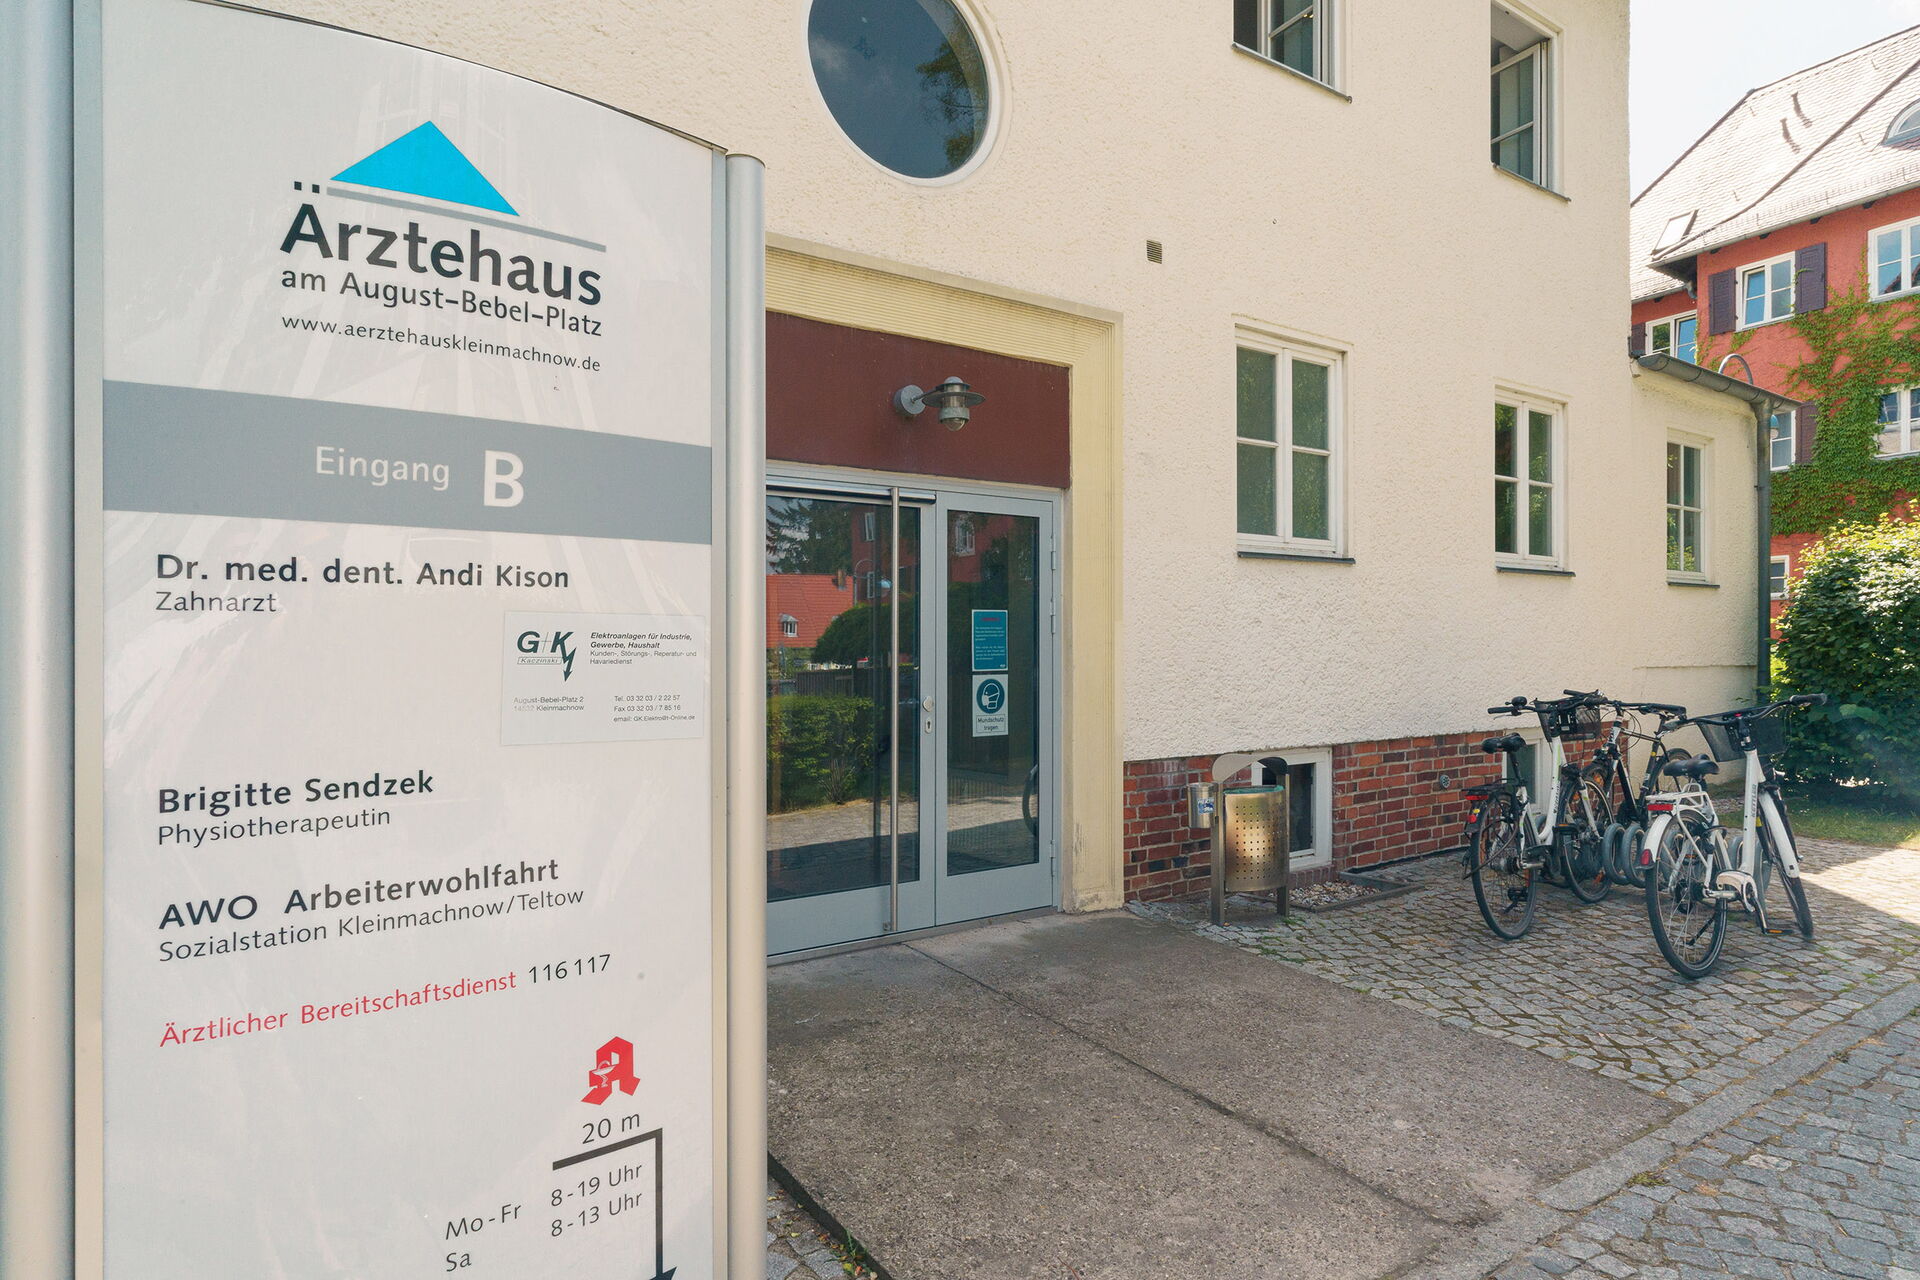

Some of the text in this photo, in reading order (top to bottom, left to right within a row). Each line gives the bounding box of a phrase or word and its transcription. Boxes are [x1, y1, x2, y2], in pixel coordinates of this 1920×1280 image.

[280, 181, 601, 306] Ärztehaus
[281, 270, 602, 337] am August-Bebel-Platz
[282, 315, 601, 372] www.aerztehauskleinmachnow.de
[315, 446, 525, 507] Eingang B
[157, 554, 569, 588] Dr. med. dent. Andi Kison
[156, 591, 277, 612] Zahnarzt
[590, 632, 646, 641] Elektroanlagen
[660, 633, 692, 641] Industrie,
[590, 641, 626, 649] Gewerbe,
[513, 696, 578, 704] August-Bebel-Platz
[159, 770, 434, 817] Brigitte Sendzek
[158, 809, 390, 848] Physiotherapeutin
[158, 859, 559, 930] AWO Arbeiterwohlfahrt
[159, 887, 584, 962] Sozialstation Kleinmachnow/Teltow
[159, 1009, 288, 1047] Ärztlicher
[300, 970, 517, 1025] Bereitschaftsdienst
[582, 1111, 641, 1144] 20 m
[609, 1164, 642, 1187] Uhr
[446, 1252, 472, 1272] Sa
[609, 1193, 642, 1216] Uhr
